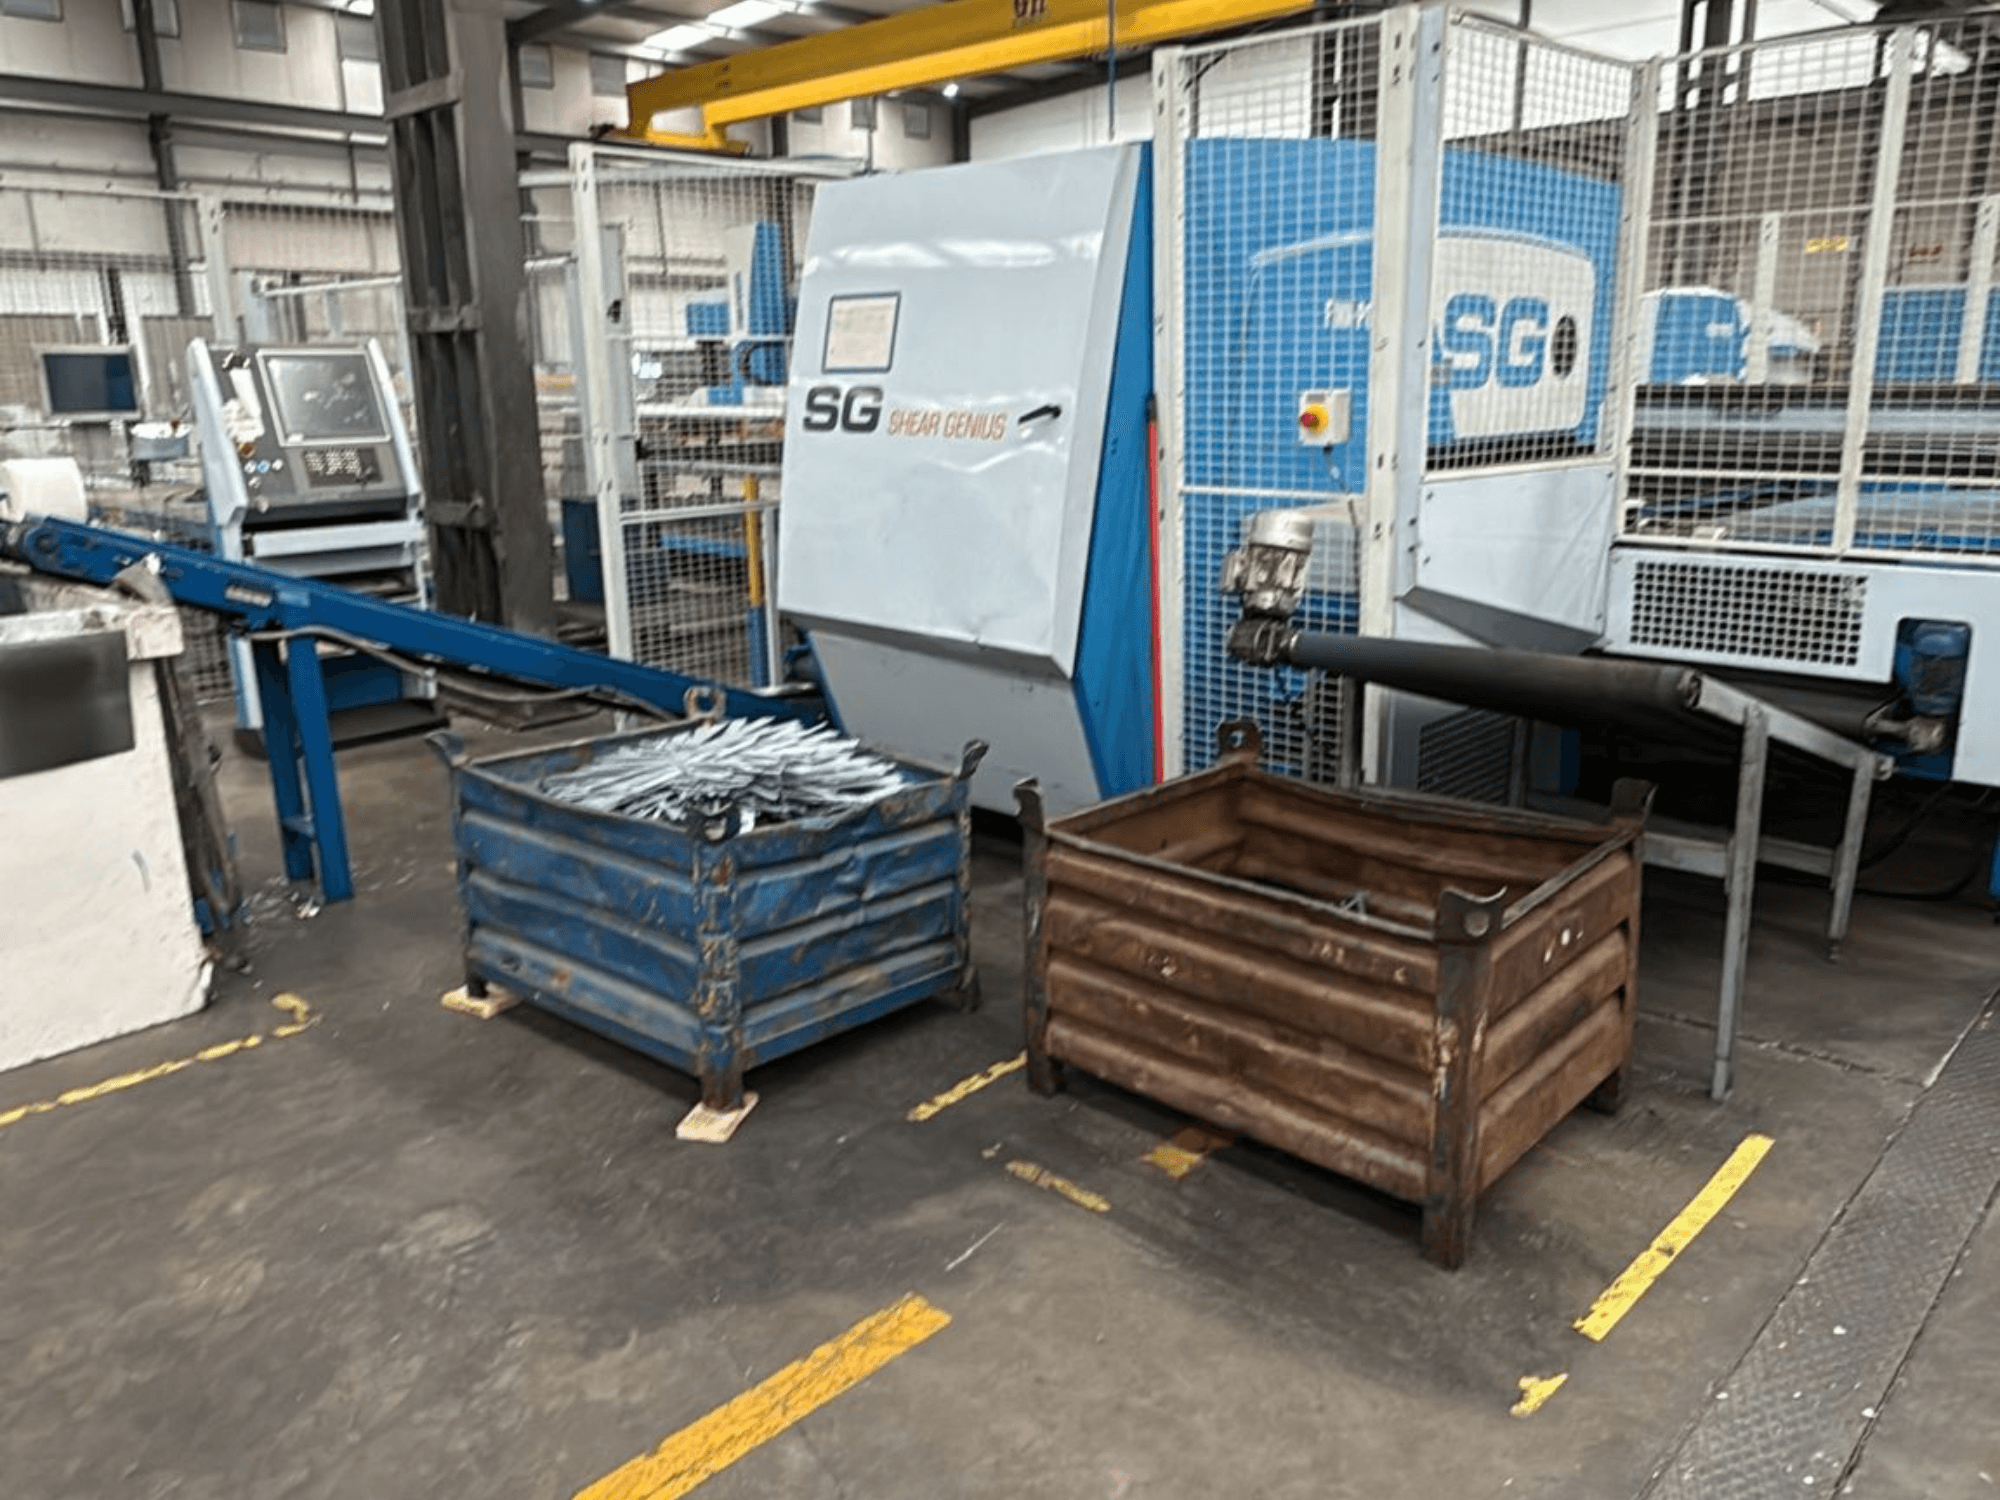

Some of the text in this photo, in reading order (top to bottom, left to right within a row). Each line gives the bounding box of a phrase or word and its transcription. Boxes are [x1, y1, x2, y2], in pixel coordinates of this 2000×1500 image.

[1443, 292, 1550, 390] SG
[802, 385, 1009, 442] SG SHEAR GENIUS
